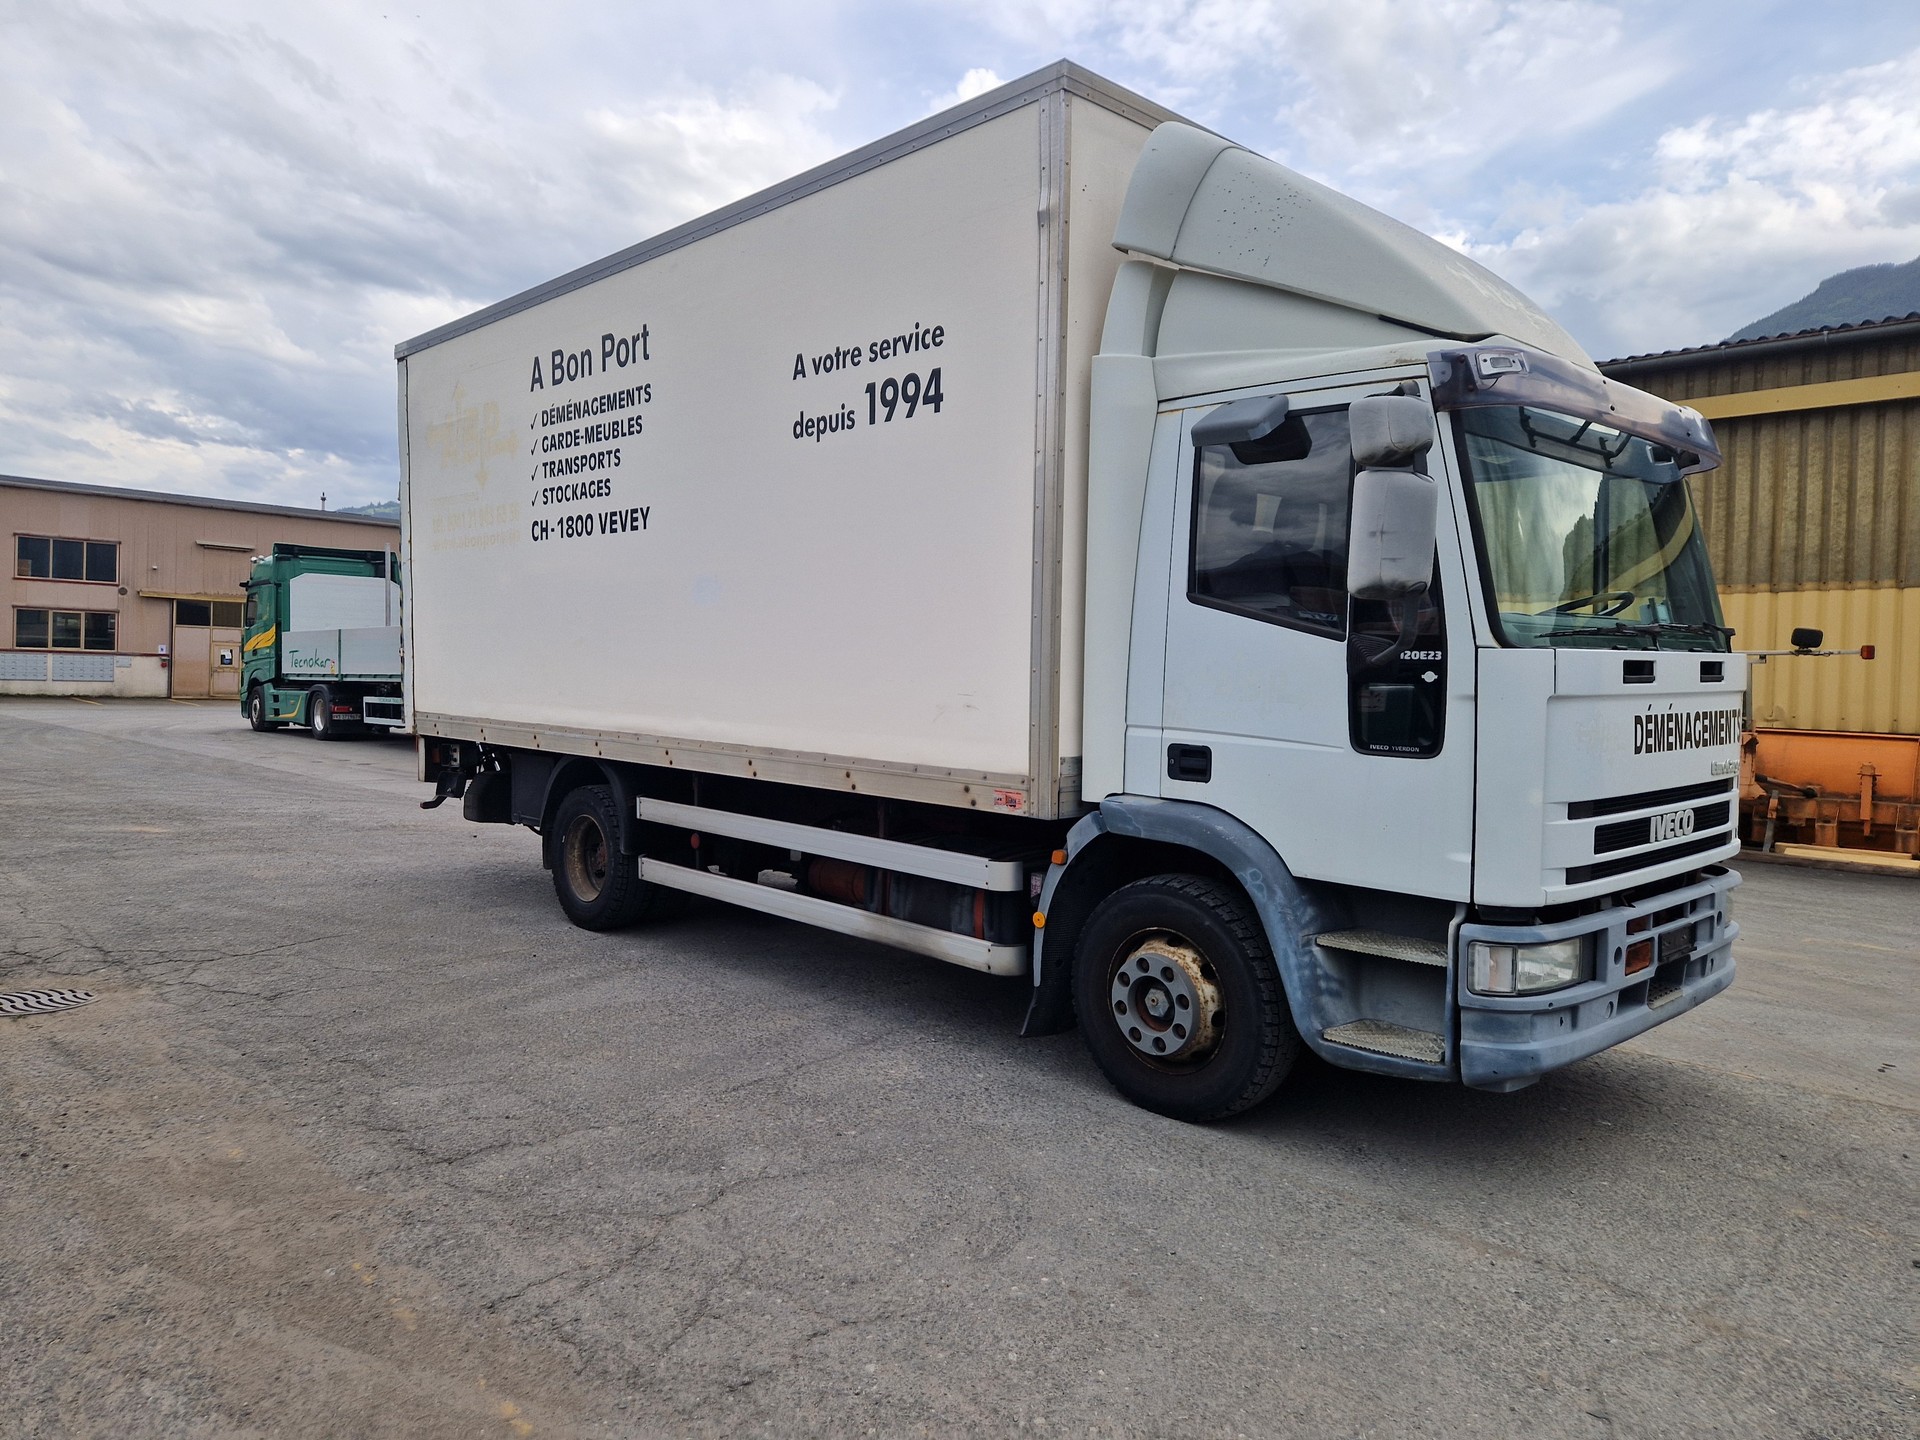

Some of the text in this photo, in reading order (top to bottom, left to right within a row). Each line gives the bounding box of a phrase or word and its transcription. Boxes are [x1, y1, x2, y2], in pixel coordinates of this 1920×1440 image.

[530, 323, 650, 392] A Bon Port
[792, 321, 945, 381] A votre service
[541, 383, 652, 427] DÉMÉNAGEMENTS
[793, 367, 944, 443] depuis 1994
[541, 415, 643, 453] GARDE-MEUBLES
[542, 448, 621, 479] TRANSPORTS
[542, 478, 612, 505] STOCKAGES
[599, 506, 650, 534] VEVEY
[1634, 703, 1741, 755] DÉMÉNAGEMENTS
[1650, 808, 1694, 843] IVECO
